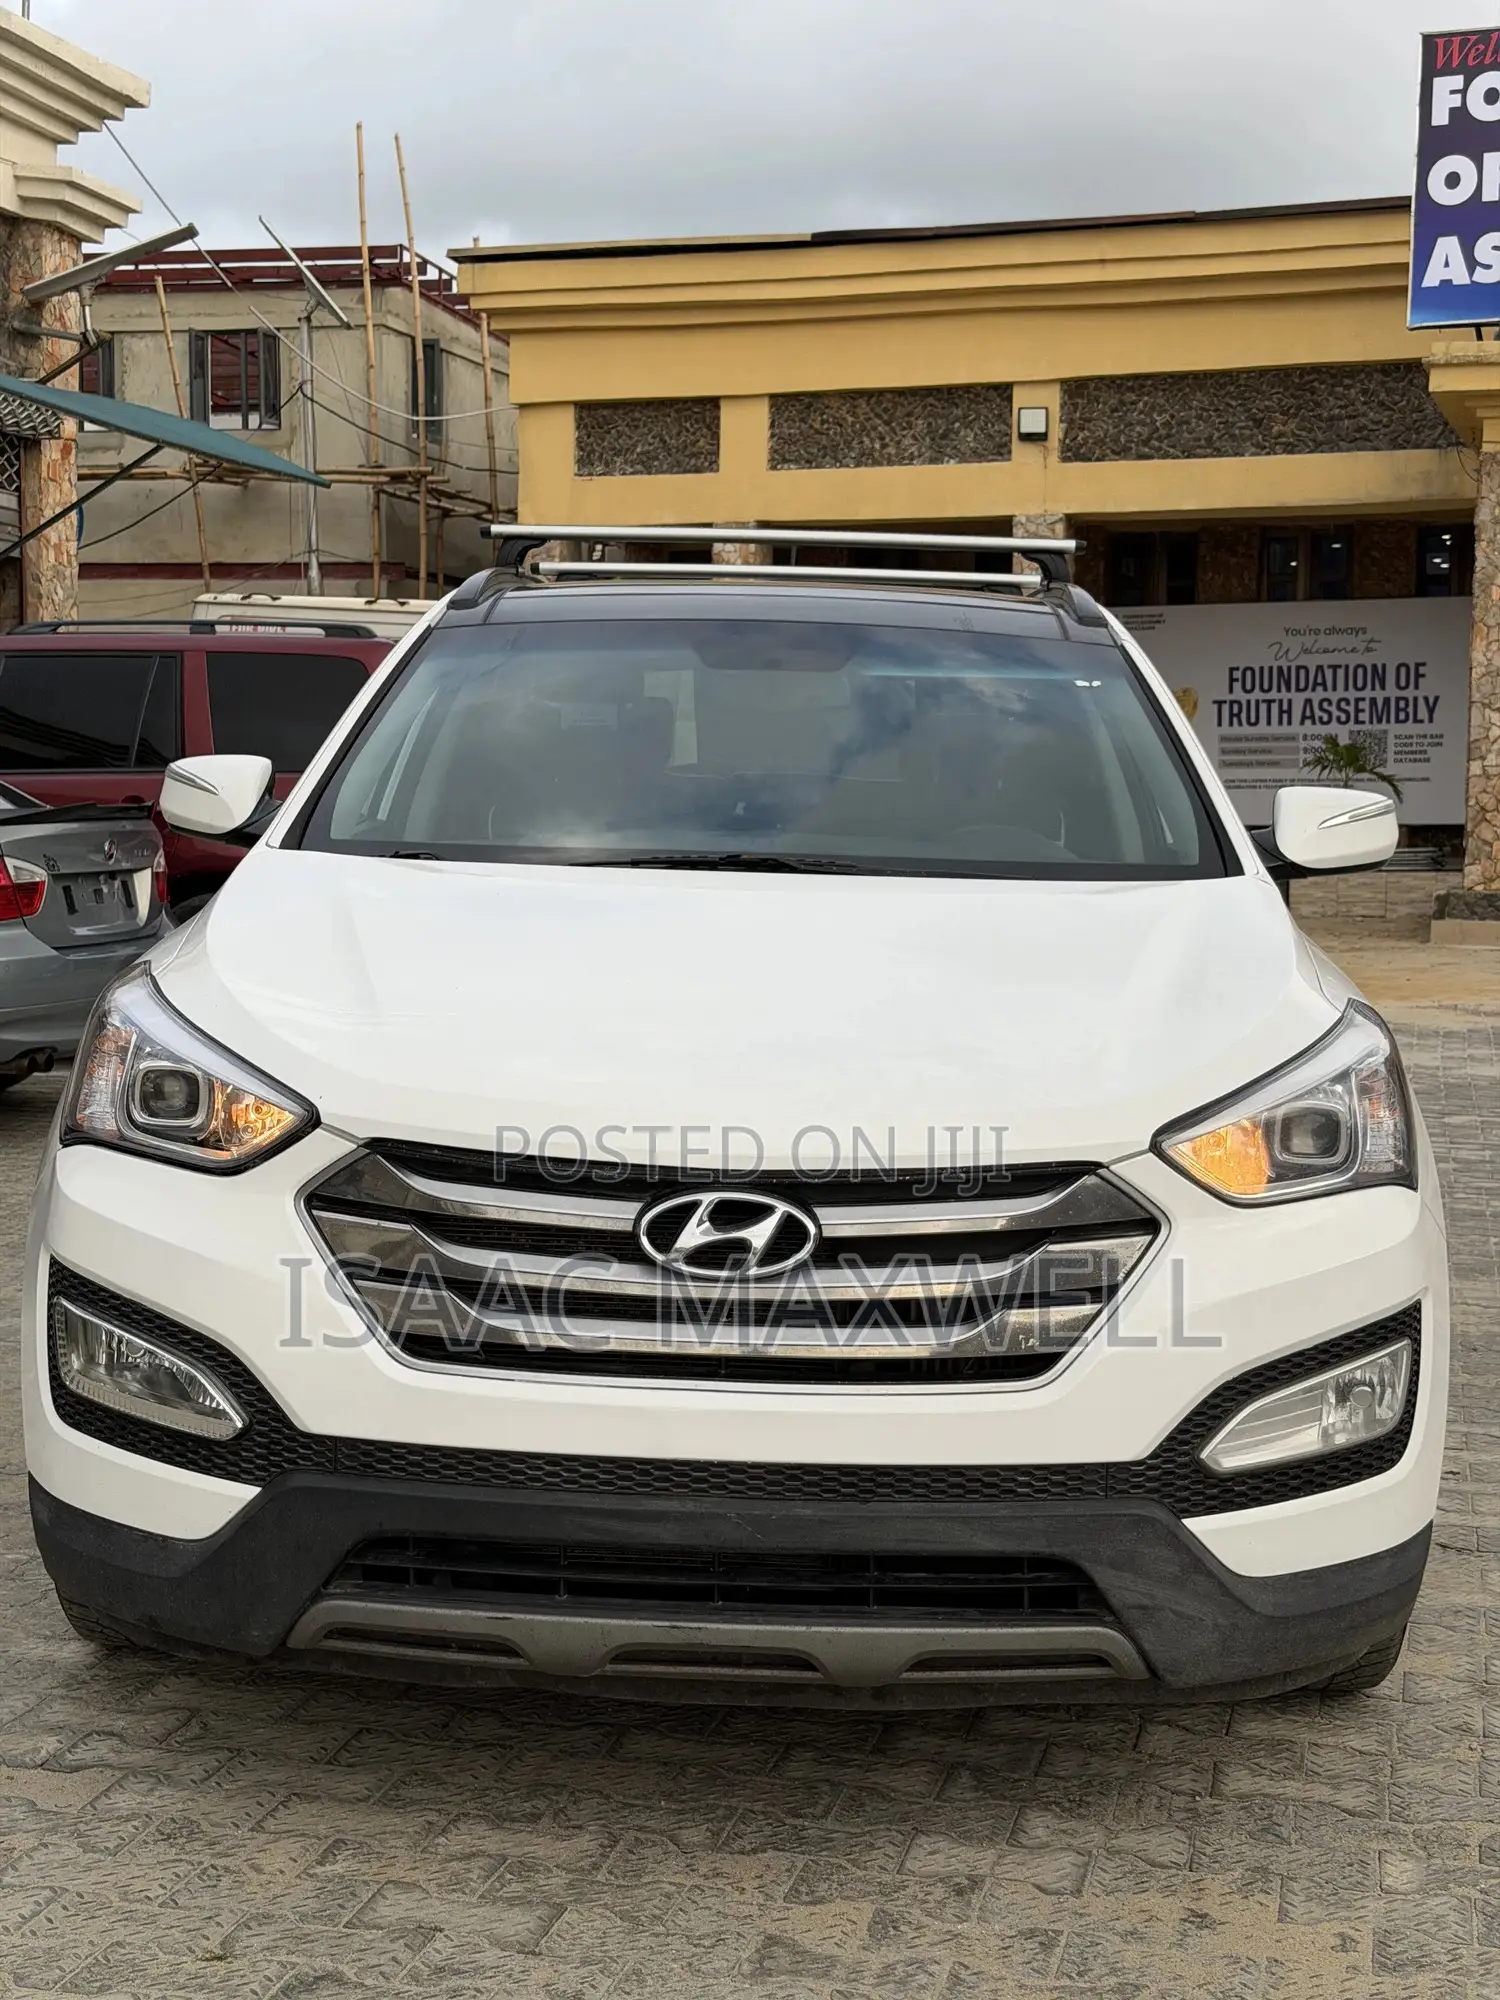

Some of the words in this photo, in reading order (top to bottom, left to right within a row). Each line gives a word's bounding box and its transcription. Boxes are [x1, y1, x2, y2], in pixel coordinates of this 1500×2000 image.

[1434, 31, 1500, 70] Wel
[1432, 70, 1500, 127] FO
[1421, 231, 1500, 288] AS
[1283, 625, 1321, 637] You're
[1323, 624, 1367, 638] always
[1267, 639, 1361, 662] Welcome
[1360, 637, 1382, 656] to
[1228, 663, 1387, 694] FOUNDATION
[1395, 662, 1427, 690] OF
[1212, 699, 1293, 727] TRUTH
[1300, 695, 1440, 726] ASSEMBLY
